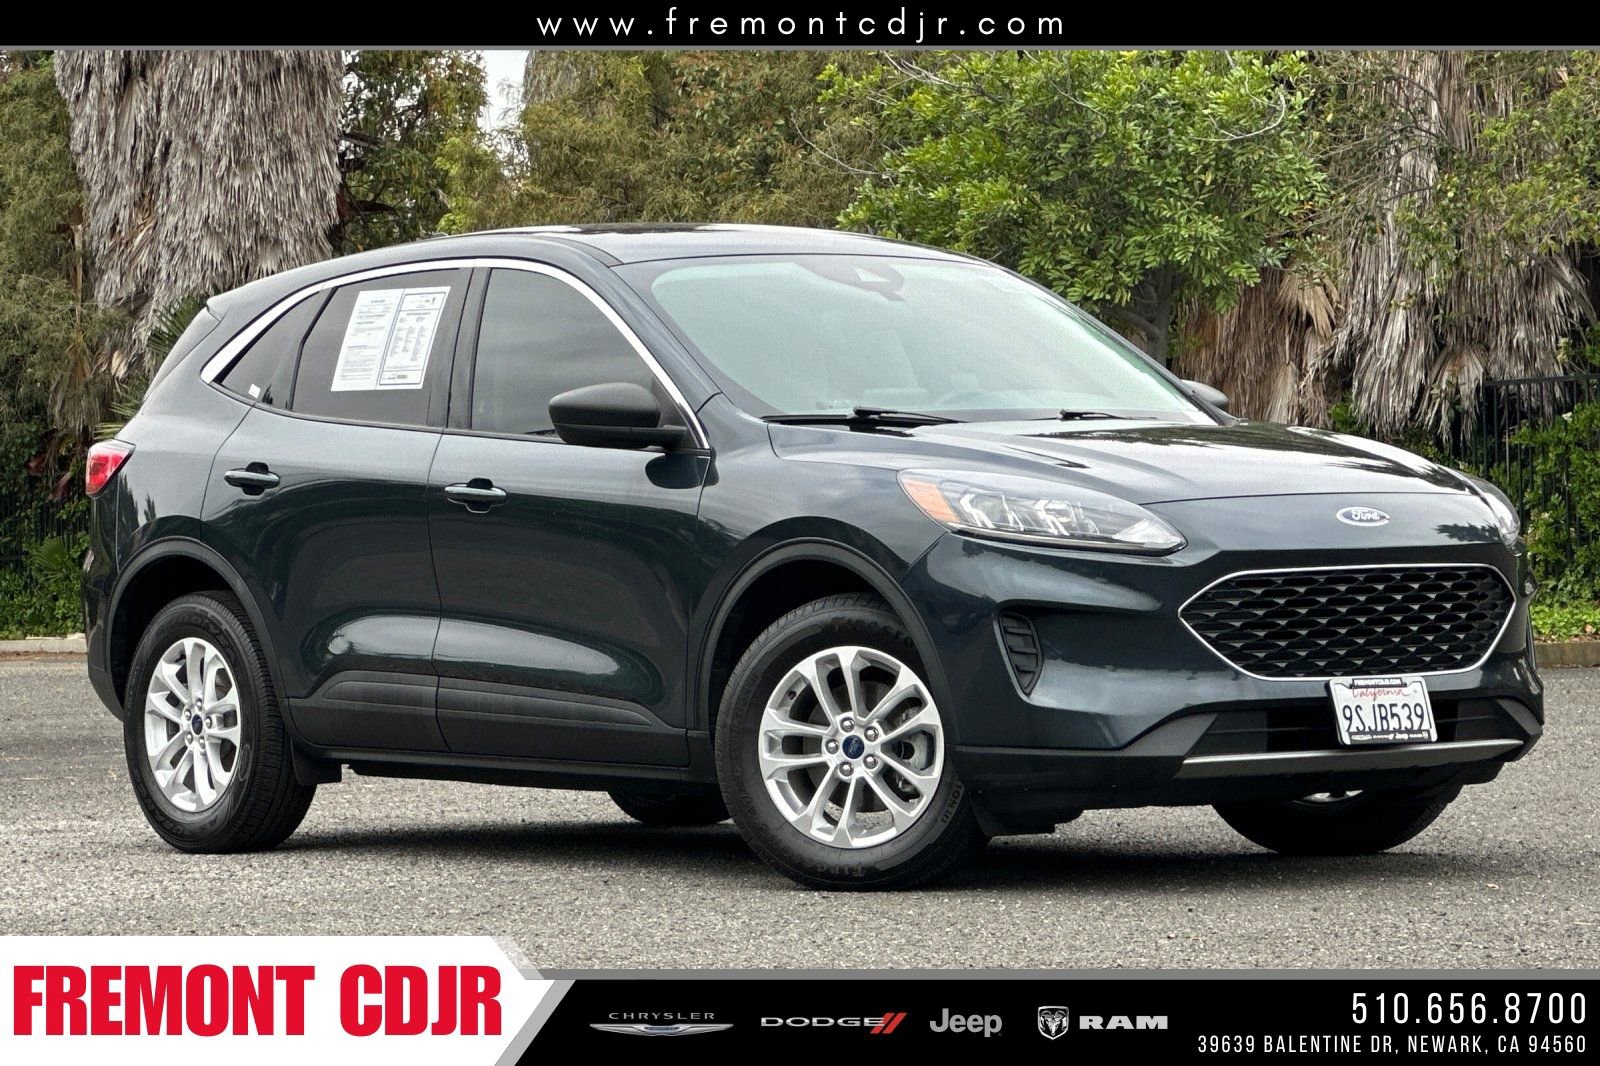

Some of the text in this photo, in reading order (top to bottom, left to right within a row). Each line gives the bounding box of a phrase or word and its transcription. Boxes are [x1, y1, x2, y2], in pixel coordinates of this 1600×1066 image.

[1350, 509, 1380, 521] Ford
[1352, 688, 1410, 702] California
[1342, 702, 1425, 732] 9SJB539
